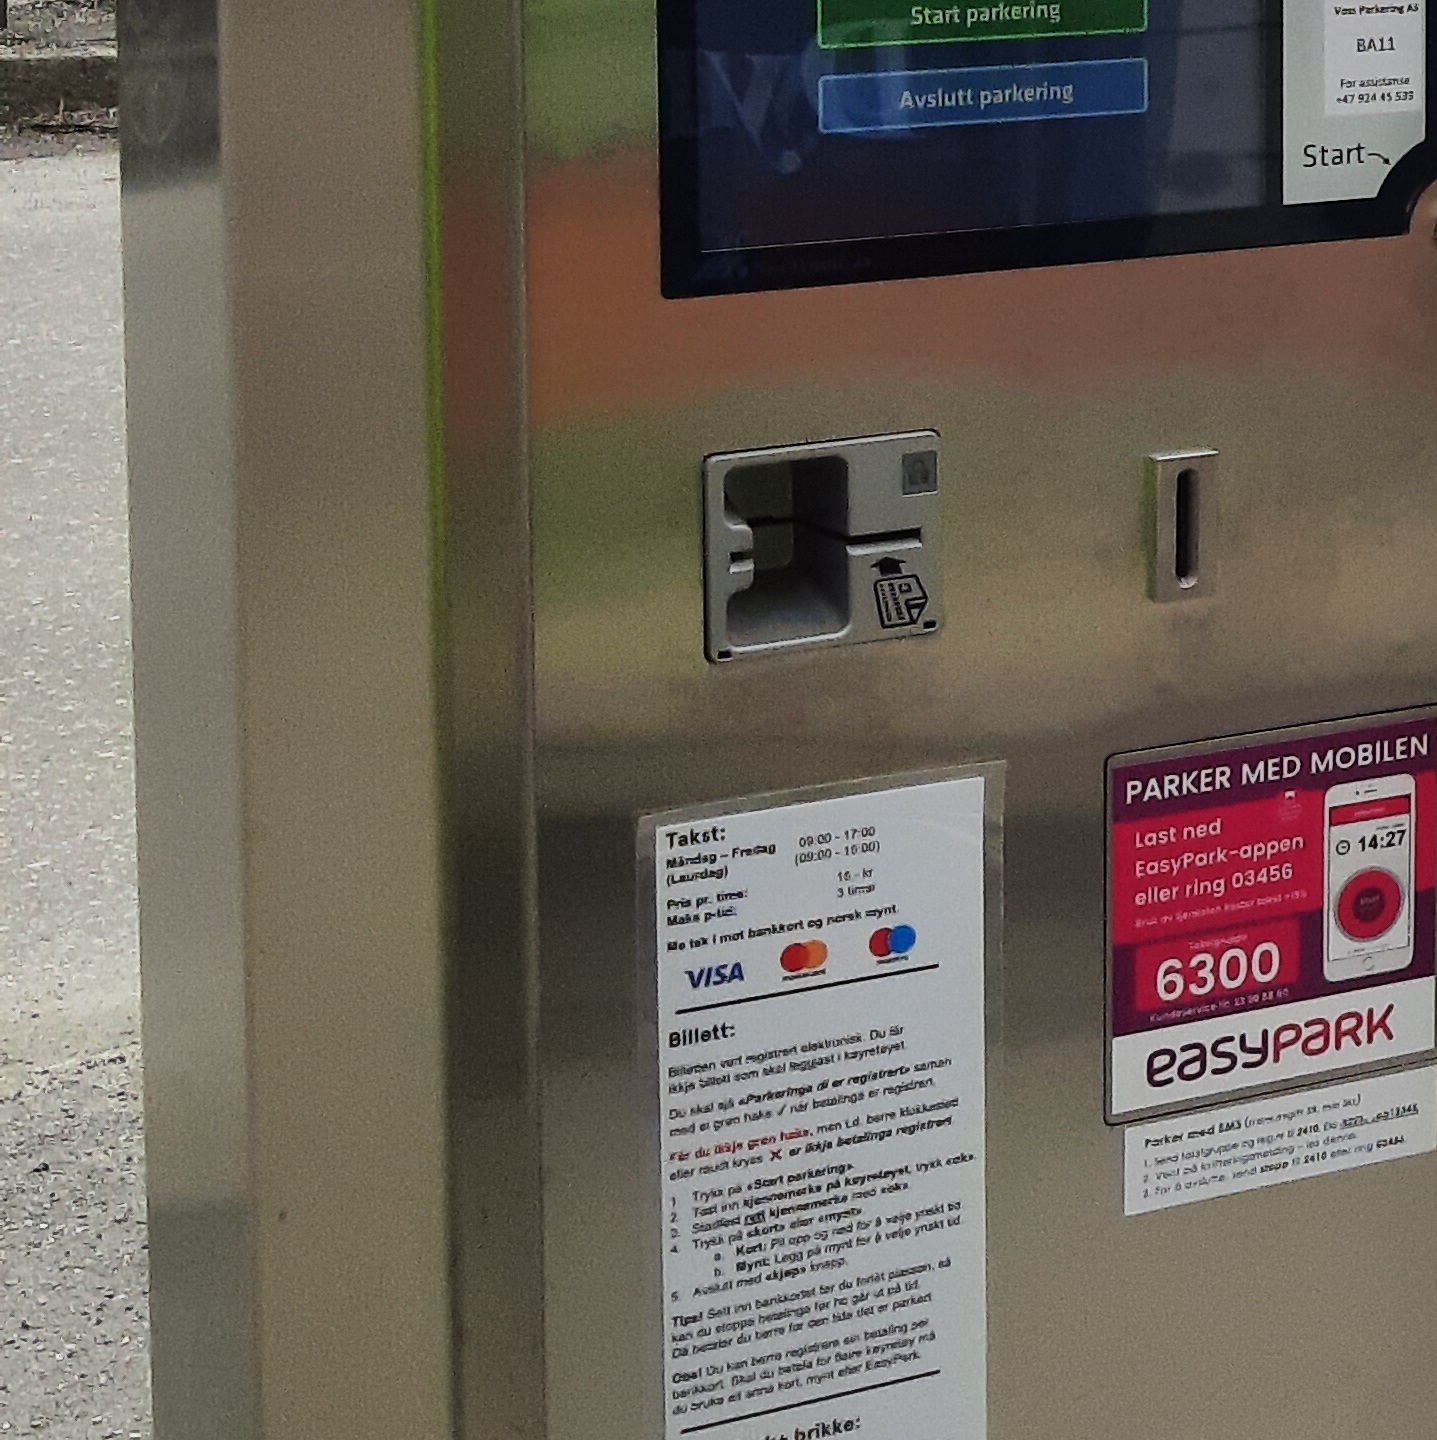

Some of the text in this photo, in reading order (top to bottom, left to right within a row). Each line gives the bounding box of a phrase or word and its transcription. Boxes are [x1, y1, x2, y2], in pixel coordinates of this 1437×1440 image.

[910, 0, 1062, 28] Start parkering
[1356, 36, 1396, 52] BA11
[898, 81, 1074, 110] Avslutt parkering
[1303, 142, 1366, 168] Start
[1126, 732, 1427, 804] PARKER MED MOBILEN
[665, 825, 725, 850] Takst:
[1135, 817, 1221, 848] Last ned
[1357, 828, 1406, 852] 14:27
[1135, 836, 1303, 878] EasyPark-appen
[1134, 862, 1292, 905] eller ring 03456
[685, 961, 746, 989] VISA
[1156, 941, 1279, 1001] 6300
[668, 1021, 735, 1048] Billett:
